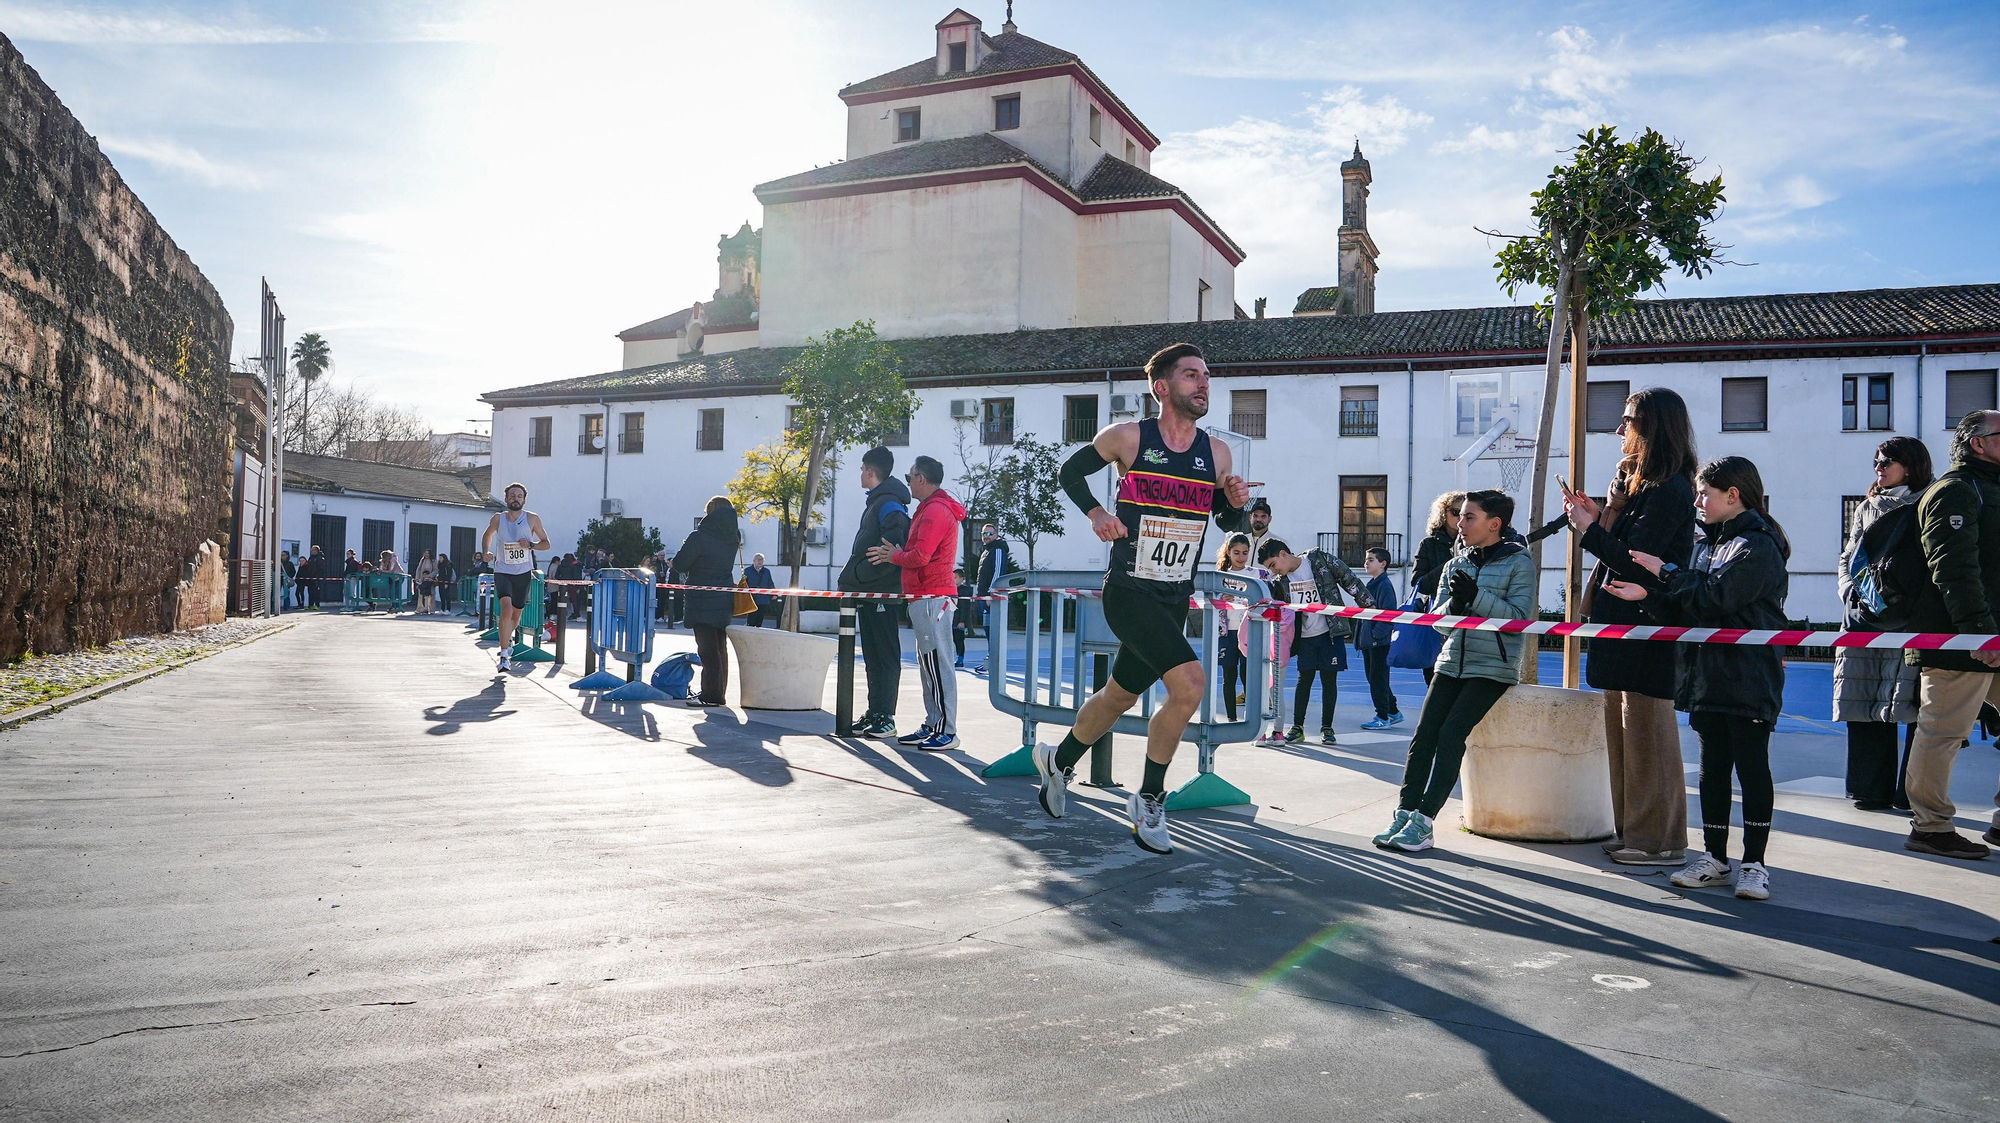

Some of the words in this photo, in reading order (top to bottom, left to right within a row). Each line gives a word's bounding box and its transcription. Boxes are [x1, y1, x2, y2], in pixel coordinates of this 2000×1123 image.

[1141, 520, 1167, 538] XLII
[509, 550, 525, 560] 308
[1151, 541, 1190, 567] 404
[1297, 589, 1319, 604] 732
